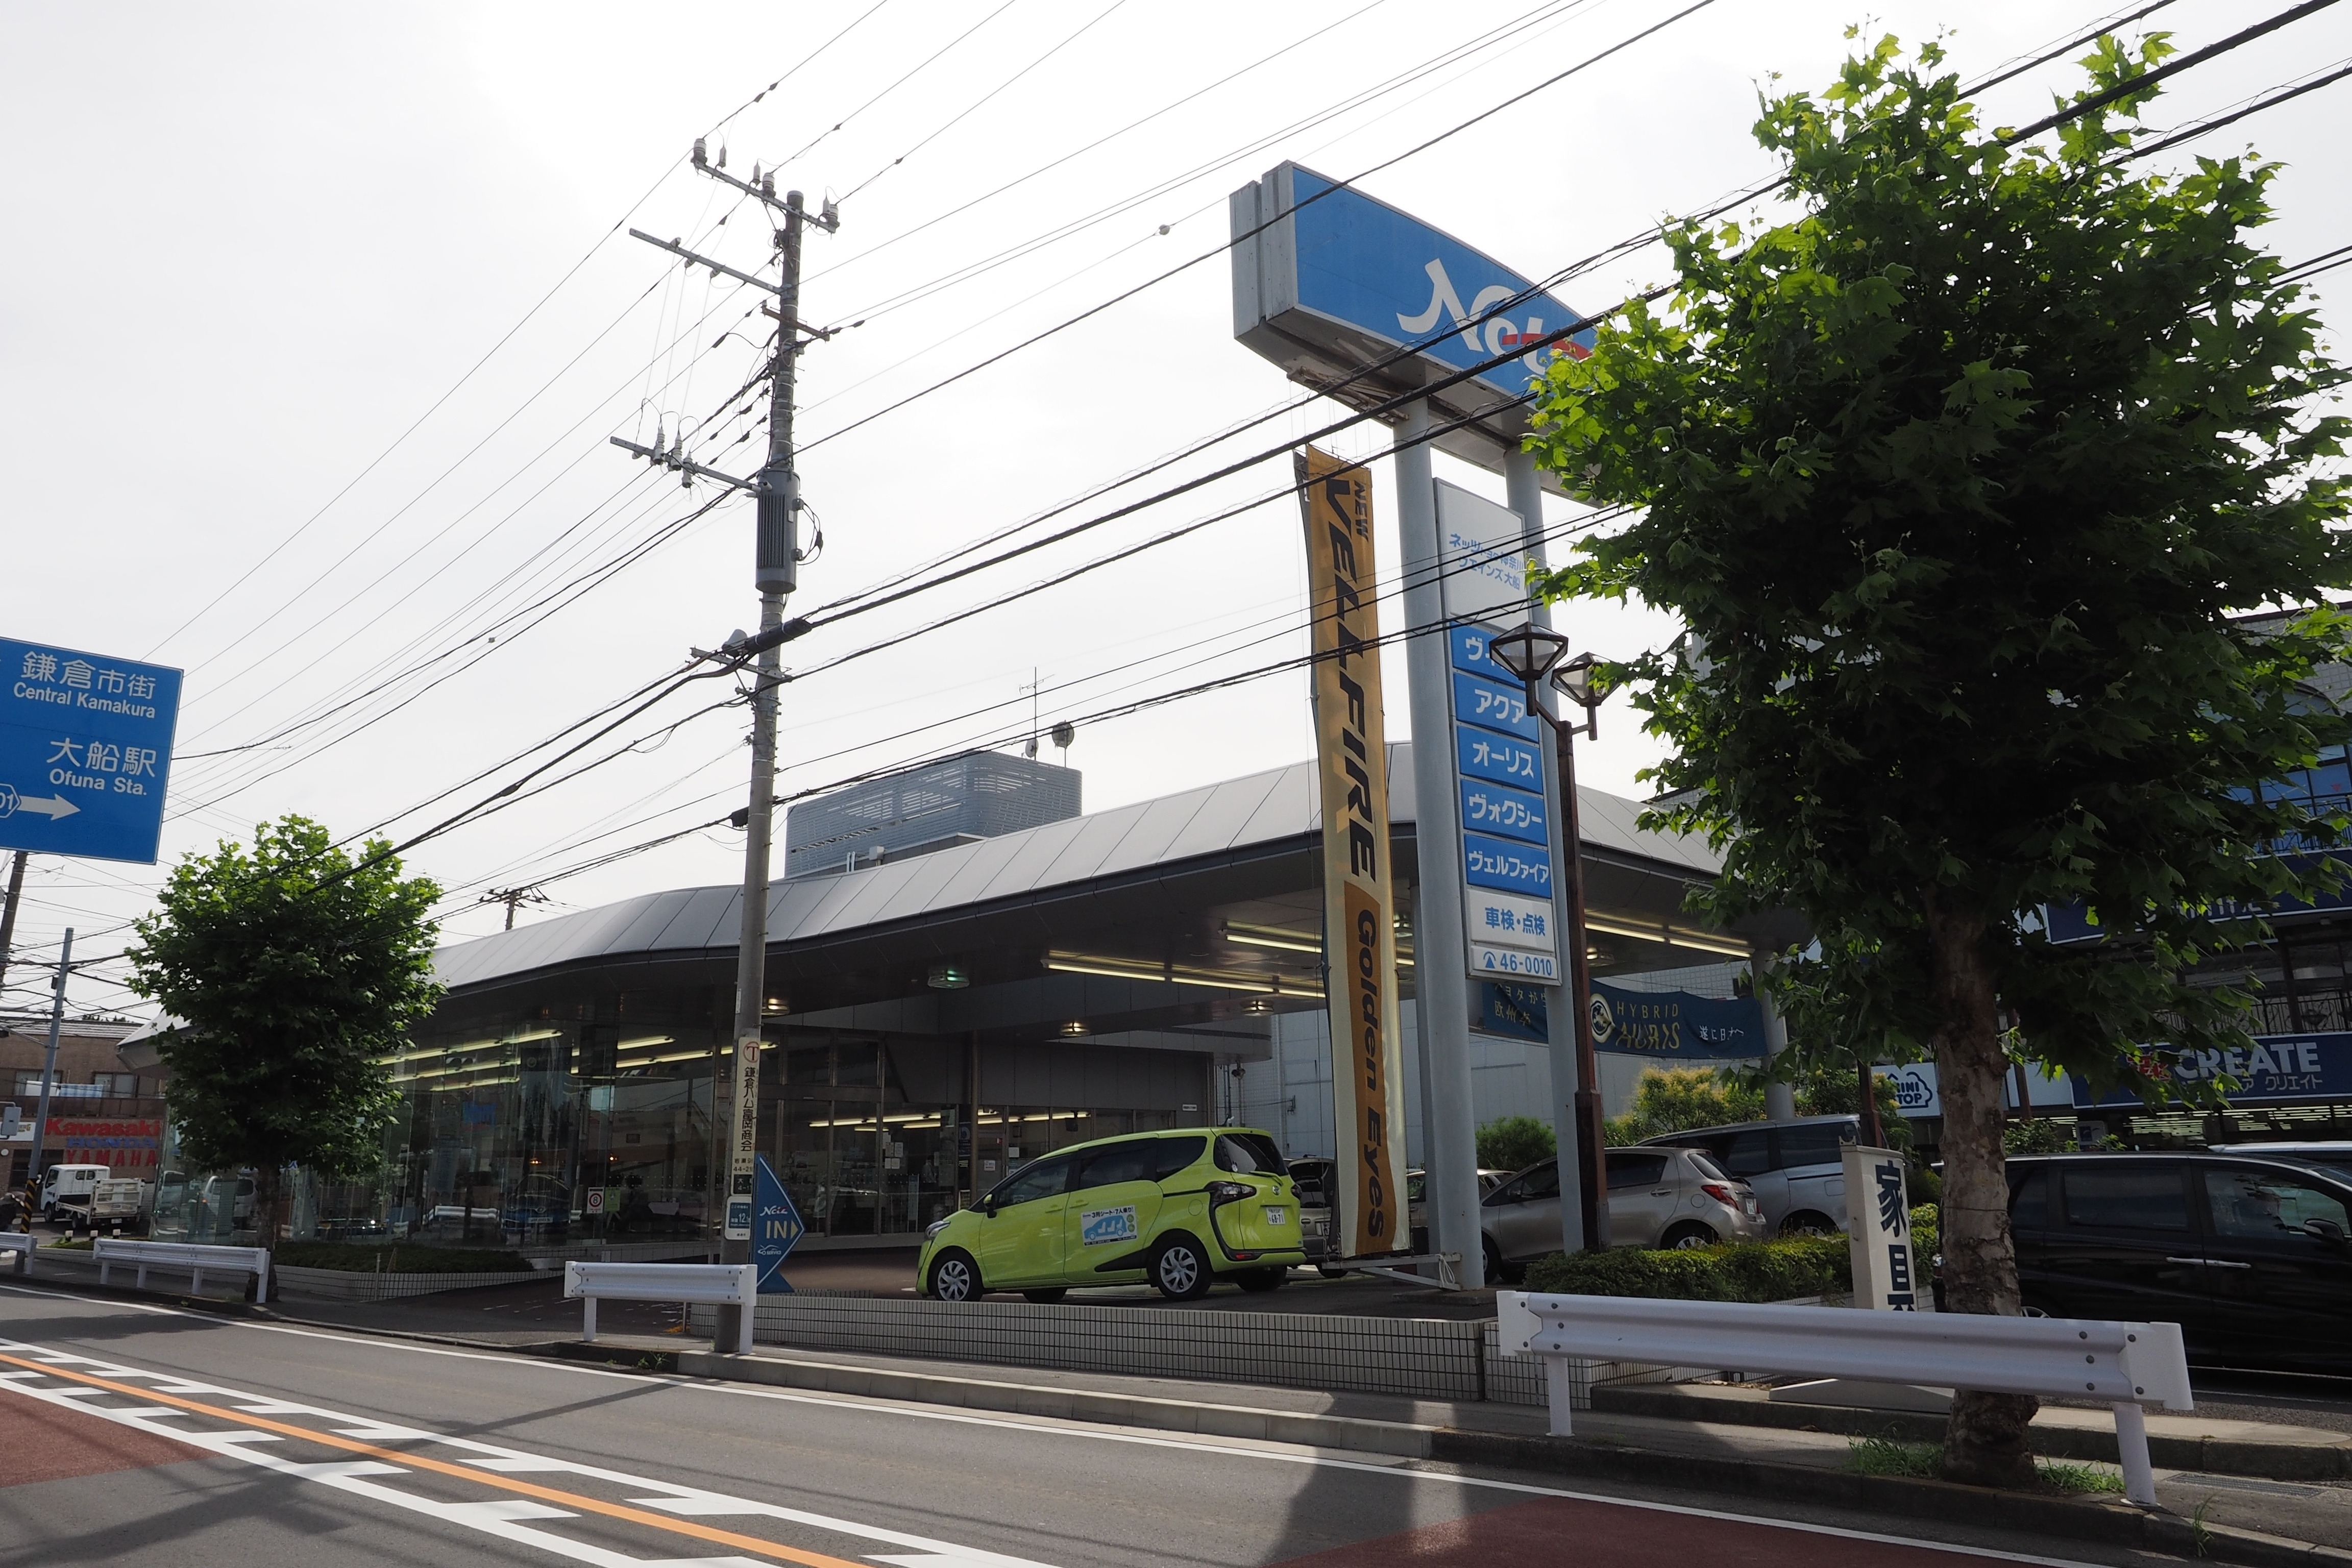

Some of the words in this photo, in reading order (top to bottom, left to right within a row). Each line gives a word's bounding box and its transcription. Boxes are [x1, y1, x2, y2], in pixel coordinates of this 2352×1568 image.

[1396, 258, 1594, 375] Net
[1354, 480, 1369, 543] NEW
[21, 651, 156, 699] 鎌倉市街
[1326, 477, 1376, 883] VELLFIRE
[14, 682, 71, 705] Central
[77, 692, 155, 718] Kamakura
[1475, 689, 1525, 724] アクア
[47, 738, 156, 777] 大船駅
[1473, 742, 1534, 779] オーリス
[50, 769, 104, 790] Ofuna
[114, 777, 147, 795] Sta.
[1468, 794, 1542, 828] ヴォクシー
[1468, 850, 1549, 884] ヴェルファイア
[1485, 907, 1546, 937] 車検・点検
[1500, 953, 1552, 976] 46-0010
[1357, 909, 1380, 1092] Golden
[1617, 1001, 1678, 1018] HYBRID
[1615, 1022, 1680, 1050] AURIS
[2174, 1042, 2321, 1079] CREATE
[1896, 1093, 1922, 1105] TOP
[2265, 1074, 2323, 1091] クリエイト
[741, 1067, 756, 1151] 鎌倉ハム富岡商会
[44, 1118, 160, 1136] Kawasaki
[67, 1137, 158, 1148] HONDA
[67, 1149, 157, 1166] YAMAHA
[1364, 1111, 1384, 1238] Eyes
[766, 1220, 787, 1239] IN
